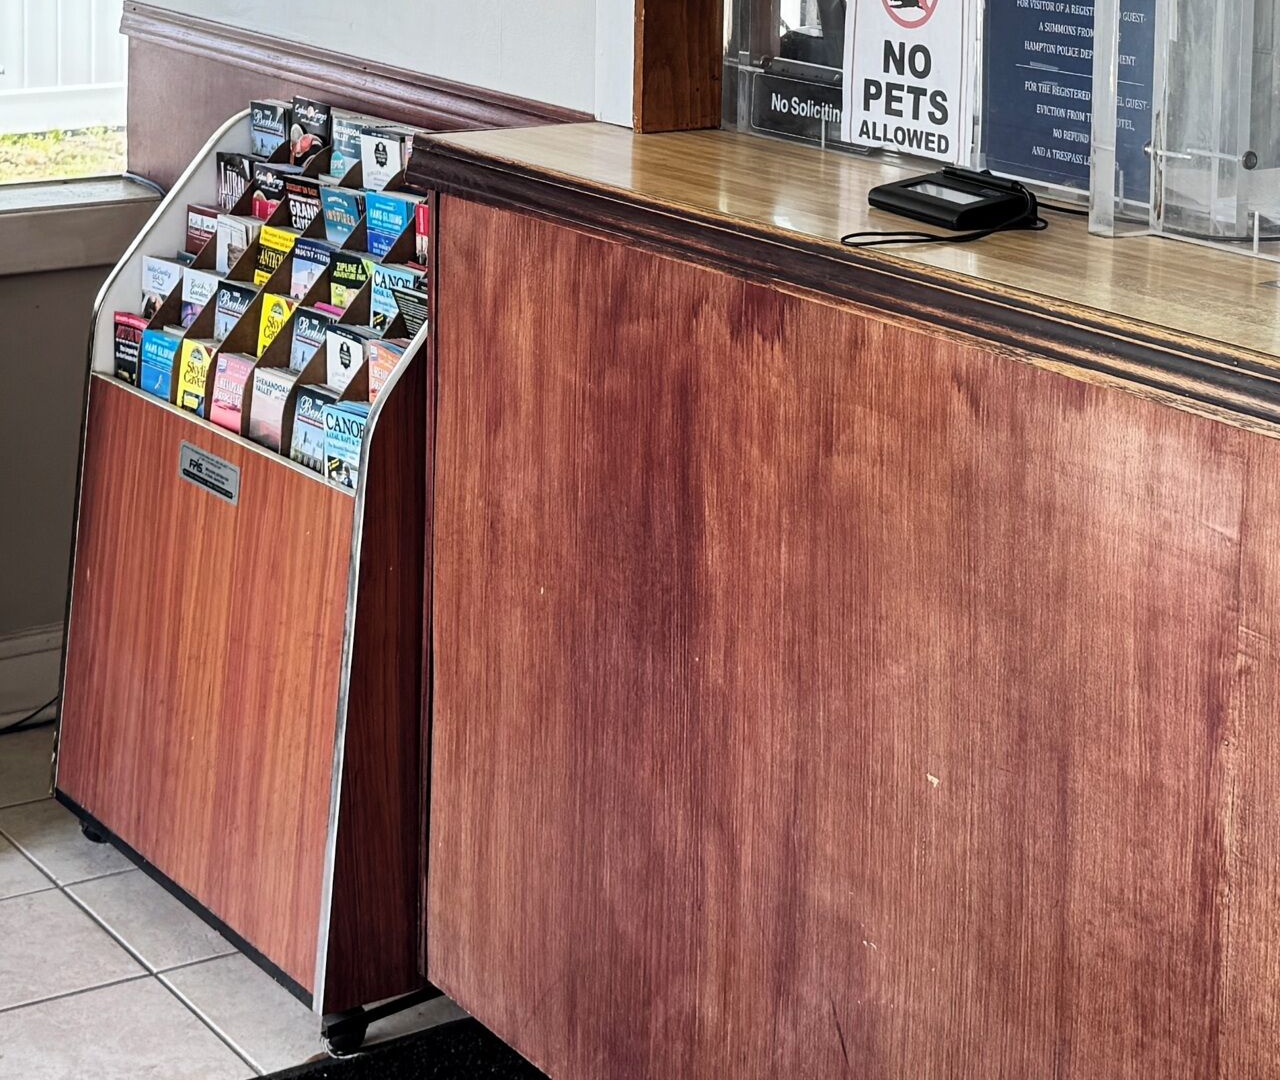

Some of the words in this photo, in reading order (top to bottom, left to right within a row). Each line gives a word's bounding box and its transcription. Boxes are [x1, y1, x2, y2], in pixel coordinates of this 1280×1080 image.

[1029, 0, 1055, 12] VISITOR
[1055, 1, 1064, 12] OF
[1044, 22, 1076, 36] SUMMONS
[1024, 40, 1056, 54] HAMPTON
[1056, 44, 1079, 57] POLICE
[882, 39, 932, 80] NO
[1024, 80, 1037, 92] FOR
[1037, 82, 1051, 94] THE
[1052, 84, 1091, 101] REGISTERED
[771, 92, 789, 114] No
[790, 97, 843, 124] Solicitin
[862, 78, 949, 126] PETS
[1036, 104, 1066, 118] EVICTION
[1066, 108, 1086, 122] FROM
[858, 119, 950, 154] ALLOWED
[1053, 128, 1063, 139] NO
[1063, 129, 1090, 143] REFUND
[1031, 146, 1046, 157] AND
[1052, 149, 1083, 165] TRESPASS
